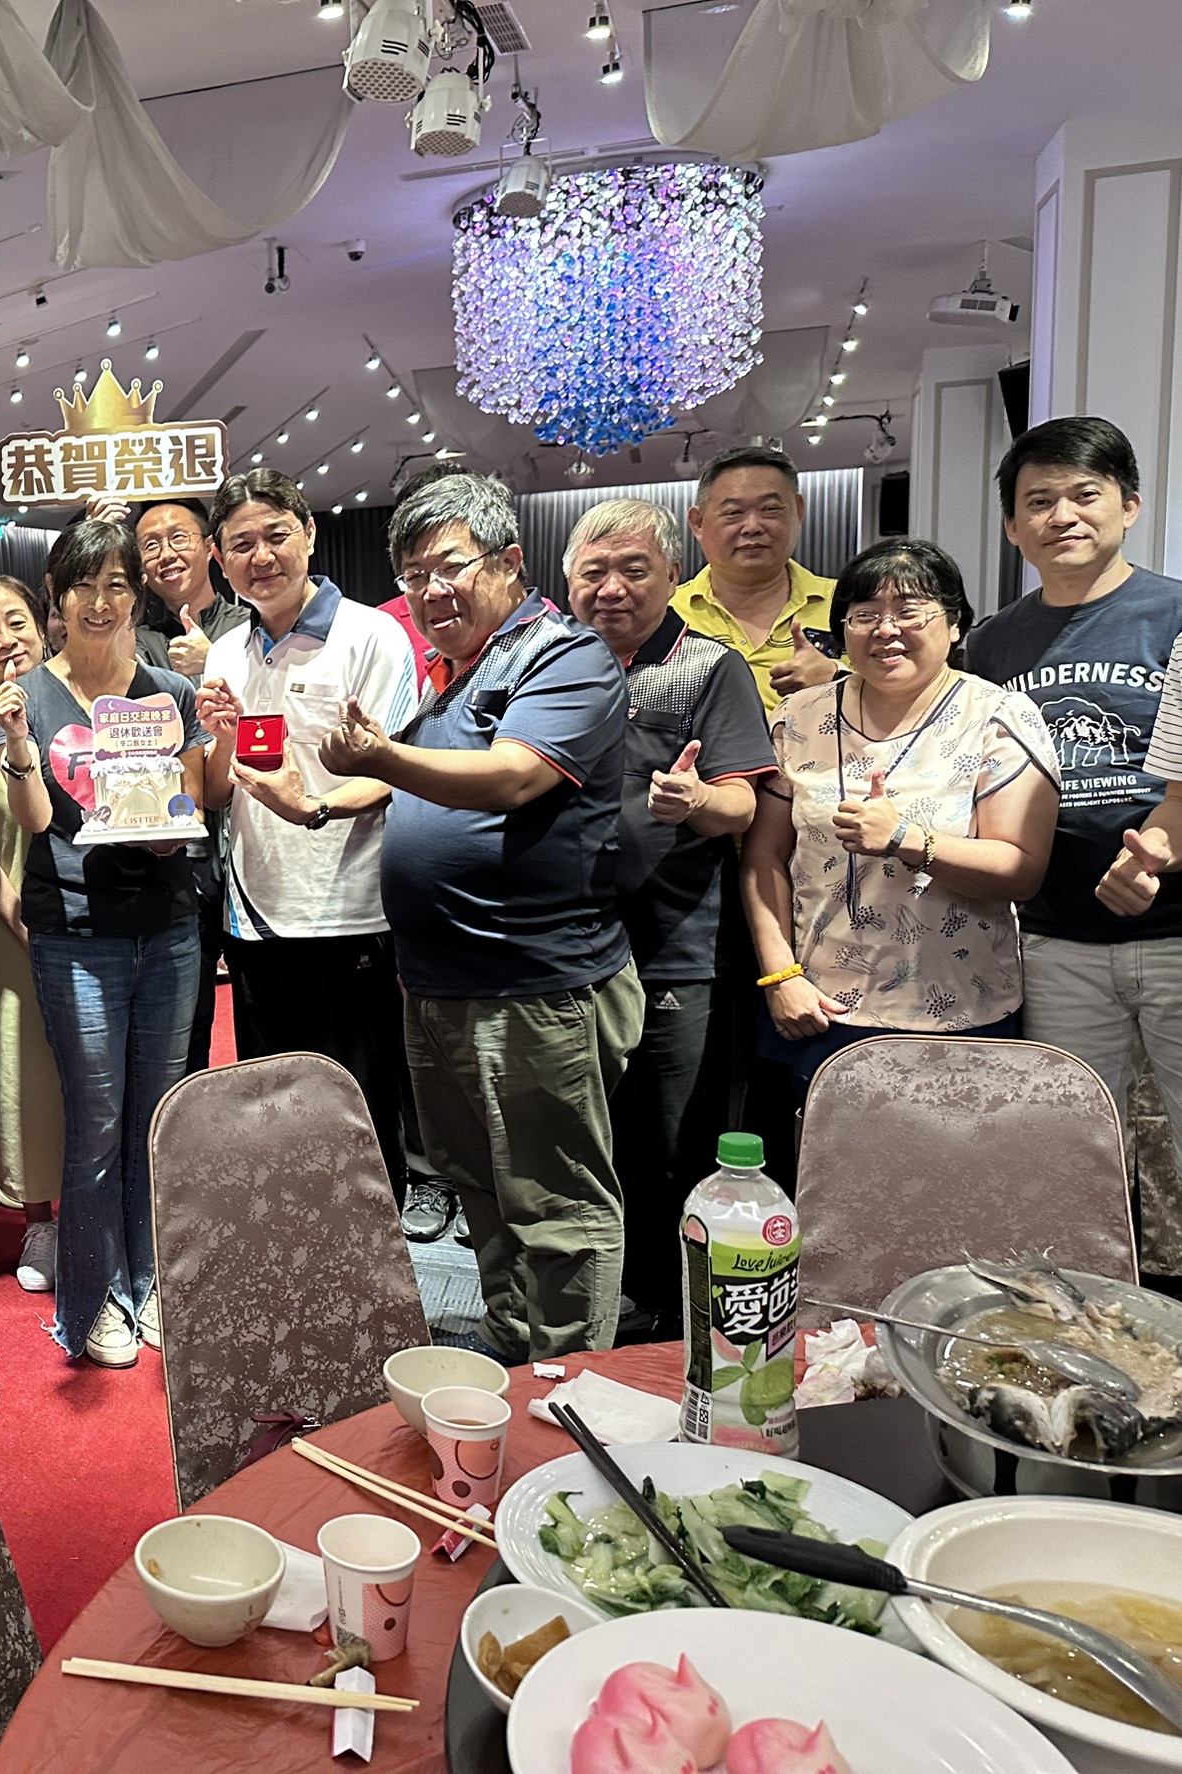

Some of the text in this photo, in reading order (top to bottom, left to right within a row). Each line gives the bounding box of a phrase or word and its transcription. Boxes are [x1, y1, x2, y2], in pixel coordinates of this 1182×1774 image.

[7, 433, 218, 496] 恭賀榮退
[1002, 662, 1166, 692] WILDERNESS
[98, 710, 172, 724] 家庭日交流晚宴
[1081, 775, 1137, 790] VIEWING
